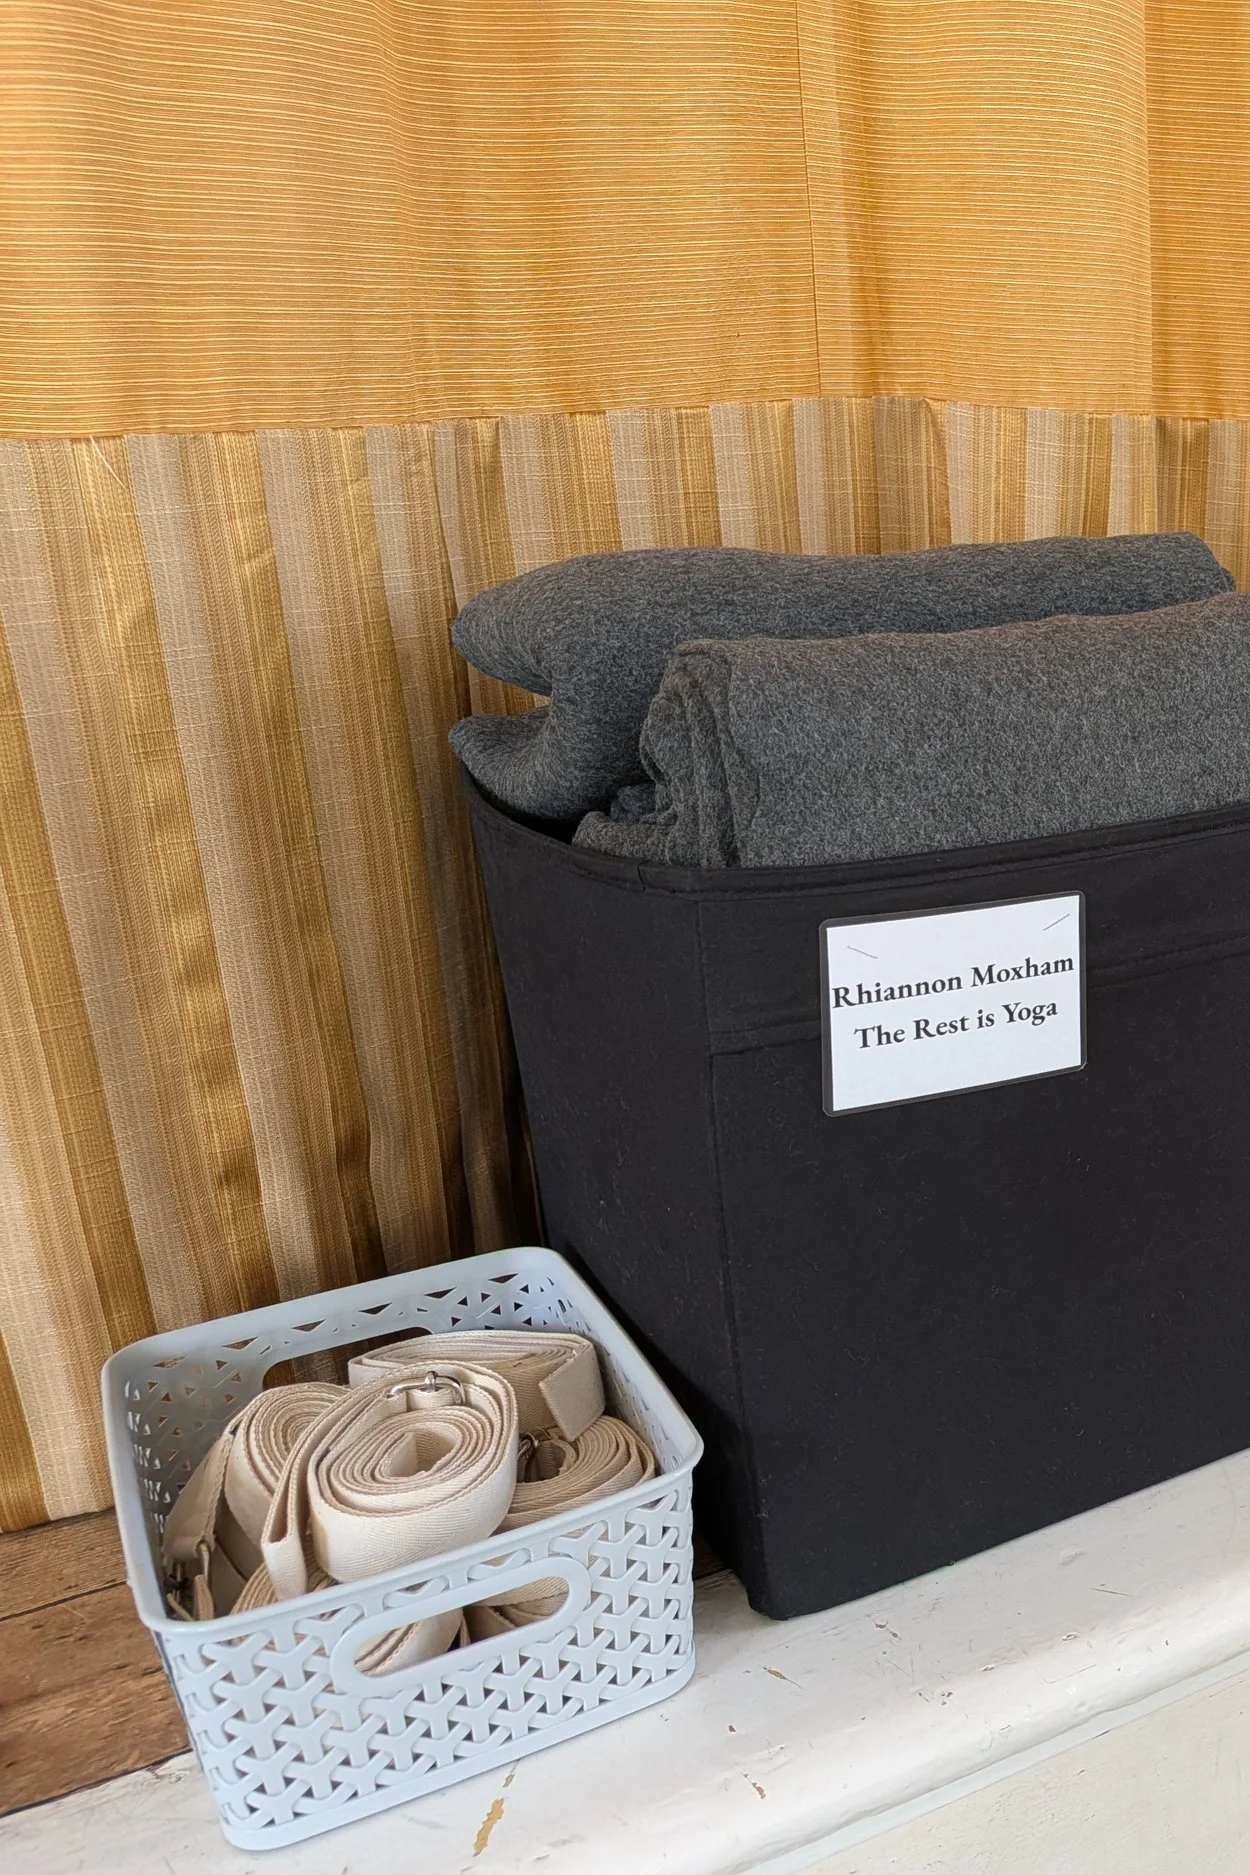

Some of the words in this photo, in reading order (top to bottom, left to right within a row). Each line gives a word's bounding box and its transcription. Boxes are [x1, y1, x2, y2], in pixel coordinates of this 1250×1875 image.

[832, 975, 962, 1008] Rhiannon
[971, 957, 1074, 987] Moxham
[854, 1025, 905, 1049] The
[913, 1015, 970, 1040] Rest
[977, 1009, 995, 1029] is
[1002, 1001, 1058, 1025] Yoga
